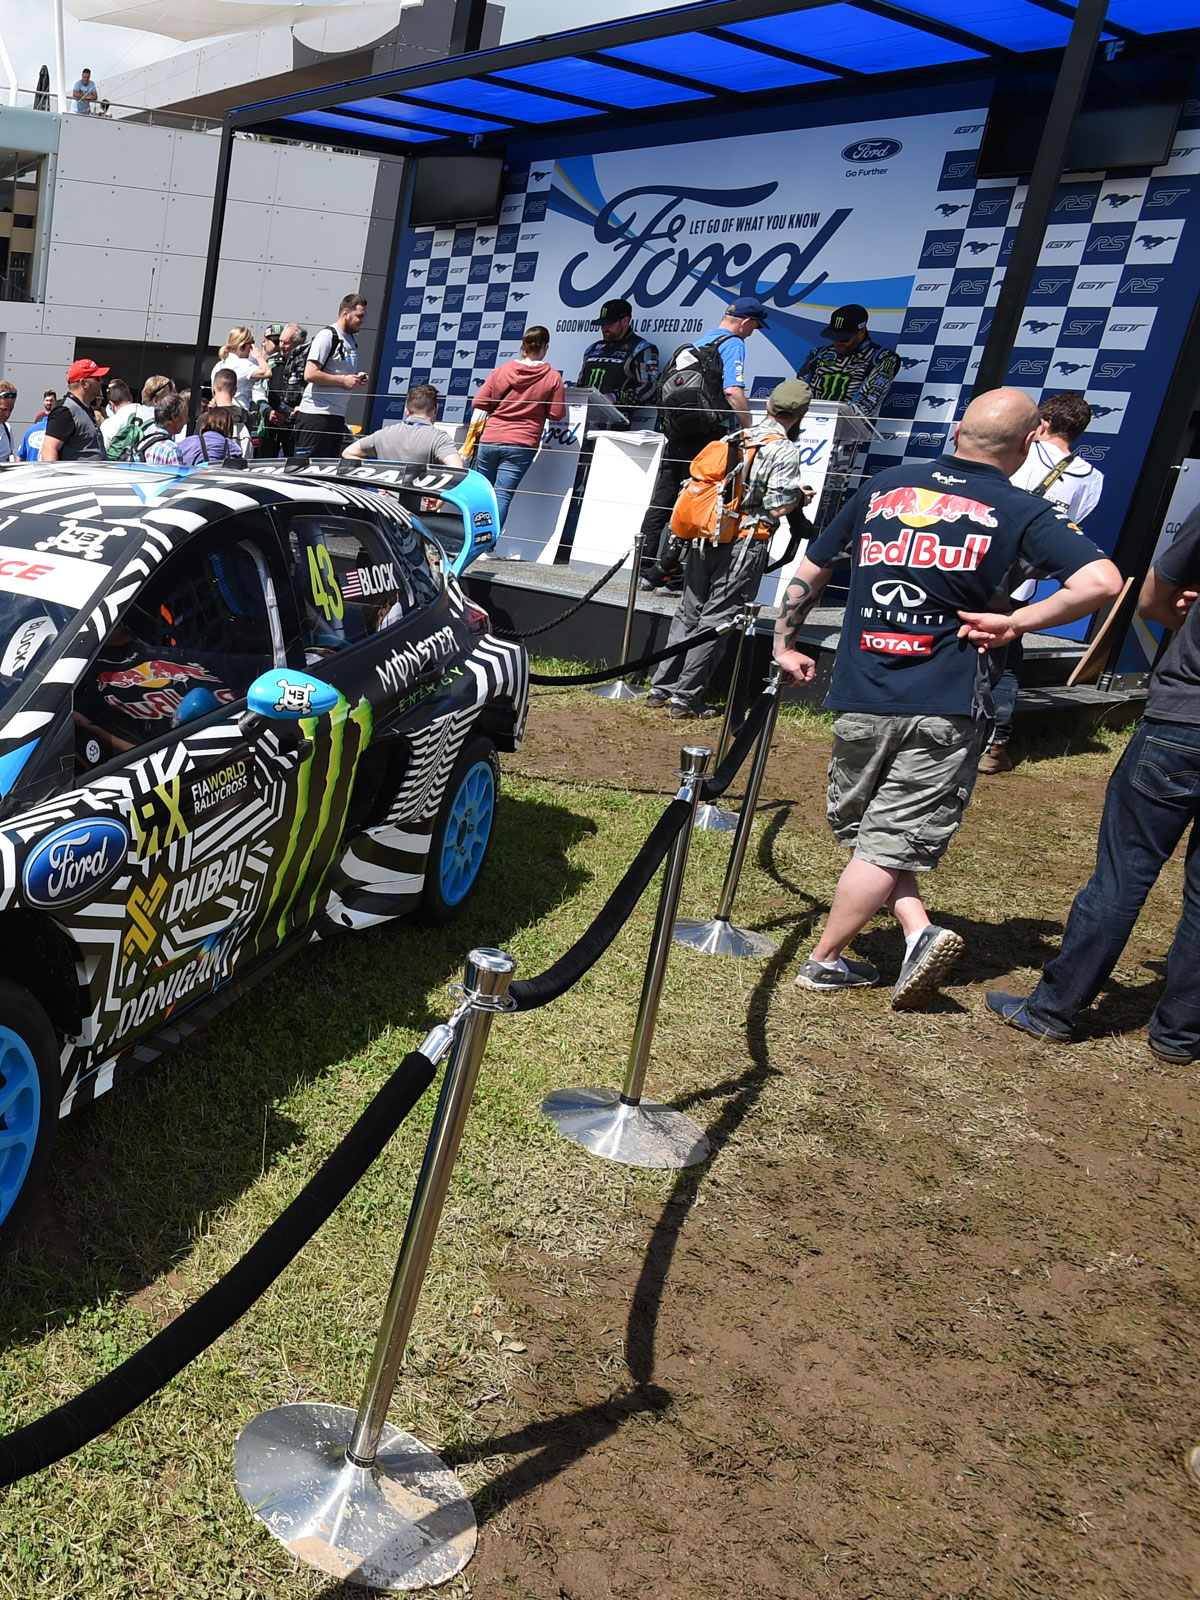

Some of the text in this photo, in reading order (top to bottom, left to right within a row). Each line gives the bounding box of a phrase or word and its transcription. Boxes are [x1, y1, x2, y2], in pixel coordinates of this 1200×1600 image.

[853, 142, 890, 159] Ford
[845, 167, 888, 178] Go Further
[689, 212, 820, 235] LET GO OF WHAT YOU KNOW
[558, 181, 854, 308] Ford
[640, 319, 652, 332] OF
[652, 318, 680, 332] SPEED
[680, 318, 704, 332] 2016
[69, 530, 99, 542] 43
[858, 529, 992, 571] Red Bull
[307, 544, 344, 622] 43
[357, 562, 400, 596] BLOCK
[13, 620, 48, 669] BLOCK
[376, 625, 460, 694] MONSTER
[863, 634, 926, 652] TOTAL
[288, 689, 305, 700] 43
[400, 666, 464, 713] ENERGY
[190, 760, 246, 802] FIA WORLD
[194, 775, 248, 816] RALLYCROSS
[46, 831, 110, 898] Ford
[166, 844, 248, 924] DUBAI
